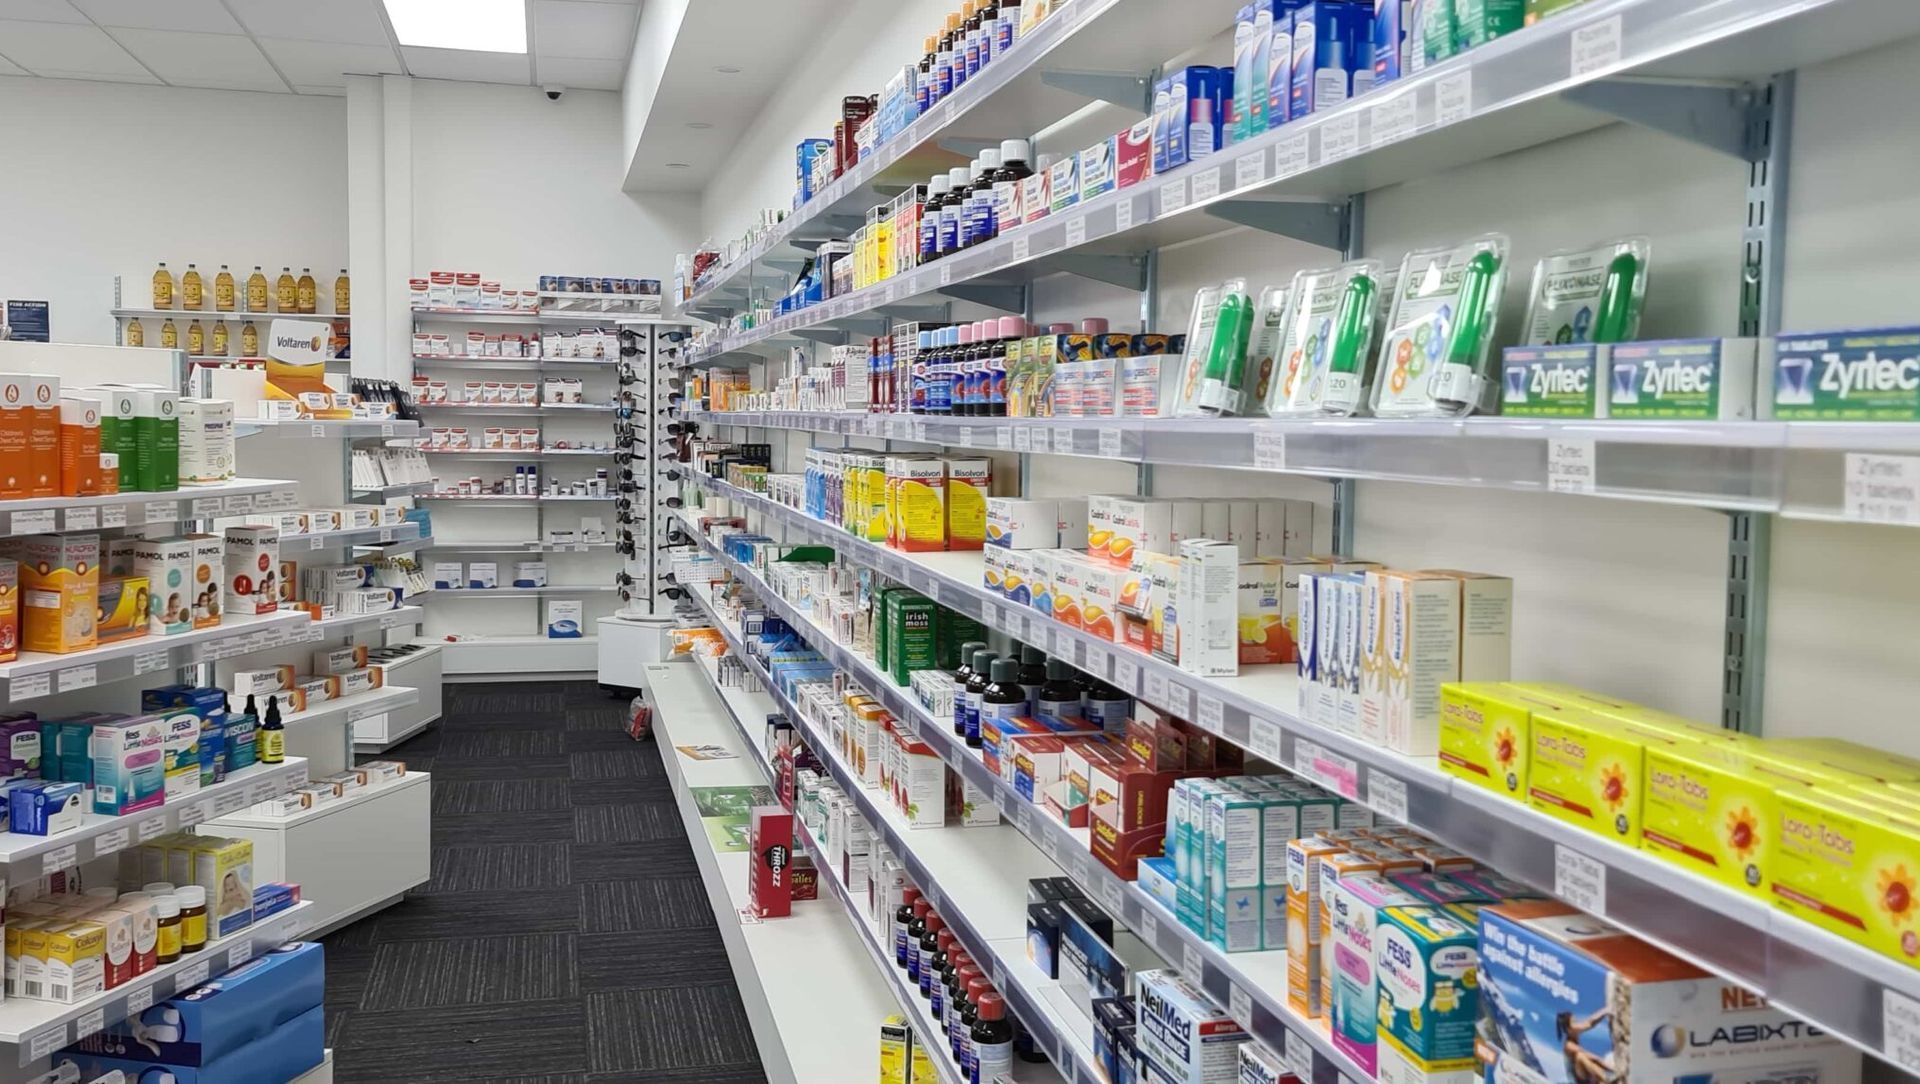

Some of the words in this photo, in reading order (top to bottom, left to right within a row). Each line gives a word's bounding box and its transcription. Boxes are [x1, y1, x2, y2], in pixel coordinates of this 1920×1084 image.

[277, 336, 310, 349] Voltaren
[1530, 363, 1588, 399] Zyrtec
[1642, 360, 1711, 400] Zyrtec
[1819, 351, 1920, 400] Zyrtec
[1859, 457, 1903, 477] Zyrtec
[226, 537, 255, 546] PAMOL
[259, 537, 278, 545] PAMOL
[136, 551, 164, 561] PAMOL
[167, 551, 190, 560] PAMOL
[197, 547, 220, 556] PAMOL
[1238, 581, 1259, 589] odral
[905, 612, 928, 620] irish
[251, 671, 276, 683] Voltaren
[347, 673, 367, 684] Voltaren
[171, 720, 192, 733] FESS
[16, 733, 36, 742] FESS
[1535, 730, 1586, 759] Lora-Tabs
[1651, 766, 1709, 800] Lora-Tabs
[1780, 809, 1854, 855] Lora-Tabs
[772, 846, 781, 888] THROZZ
[1387, 938, 1412, 969] FESS
[1483, 920, 1506, 947] Win
[1507, 933, 1527, 957] the
[1527, 944, 1566, 978] battle
[1482, 942, 1525, 975] against
[1524, 964, 1579, 1005] allergies
[1140, 982, 1191, 1041] NeilMed
